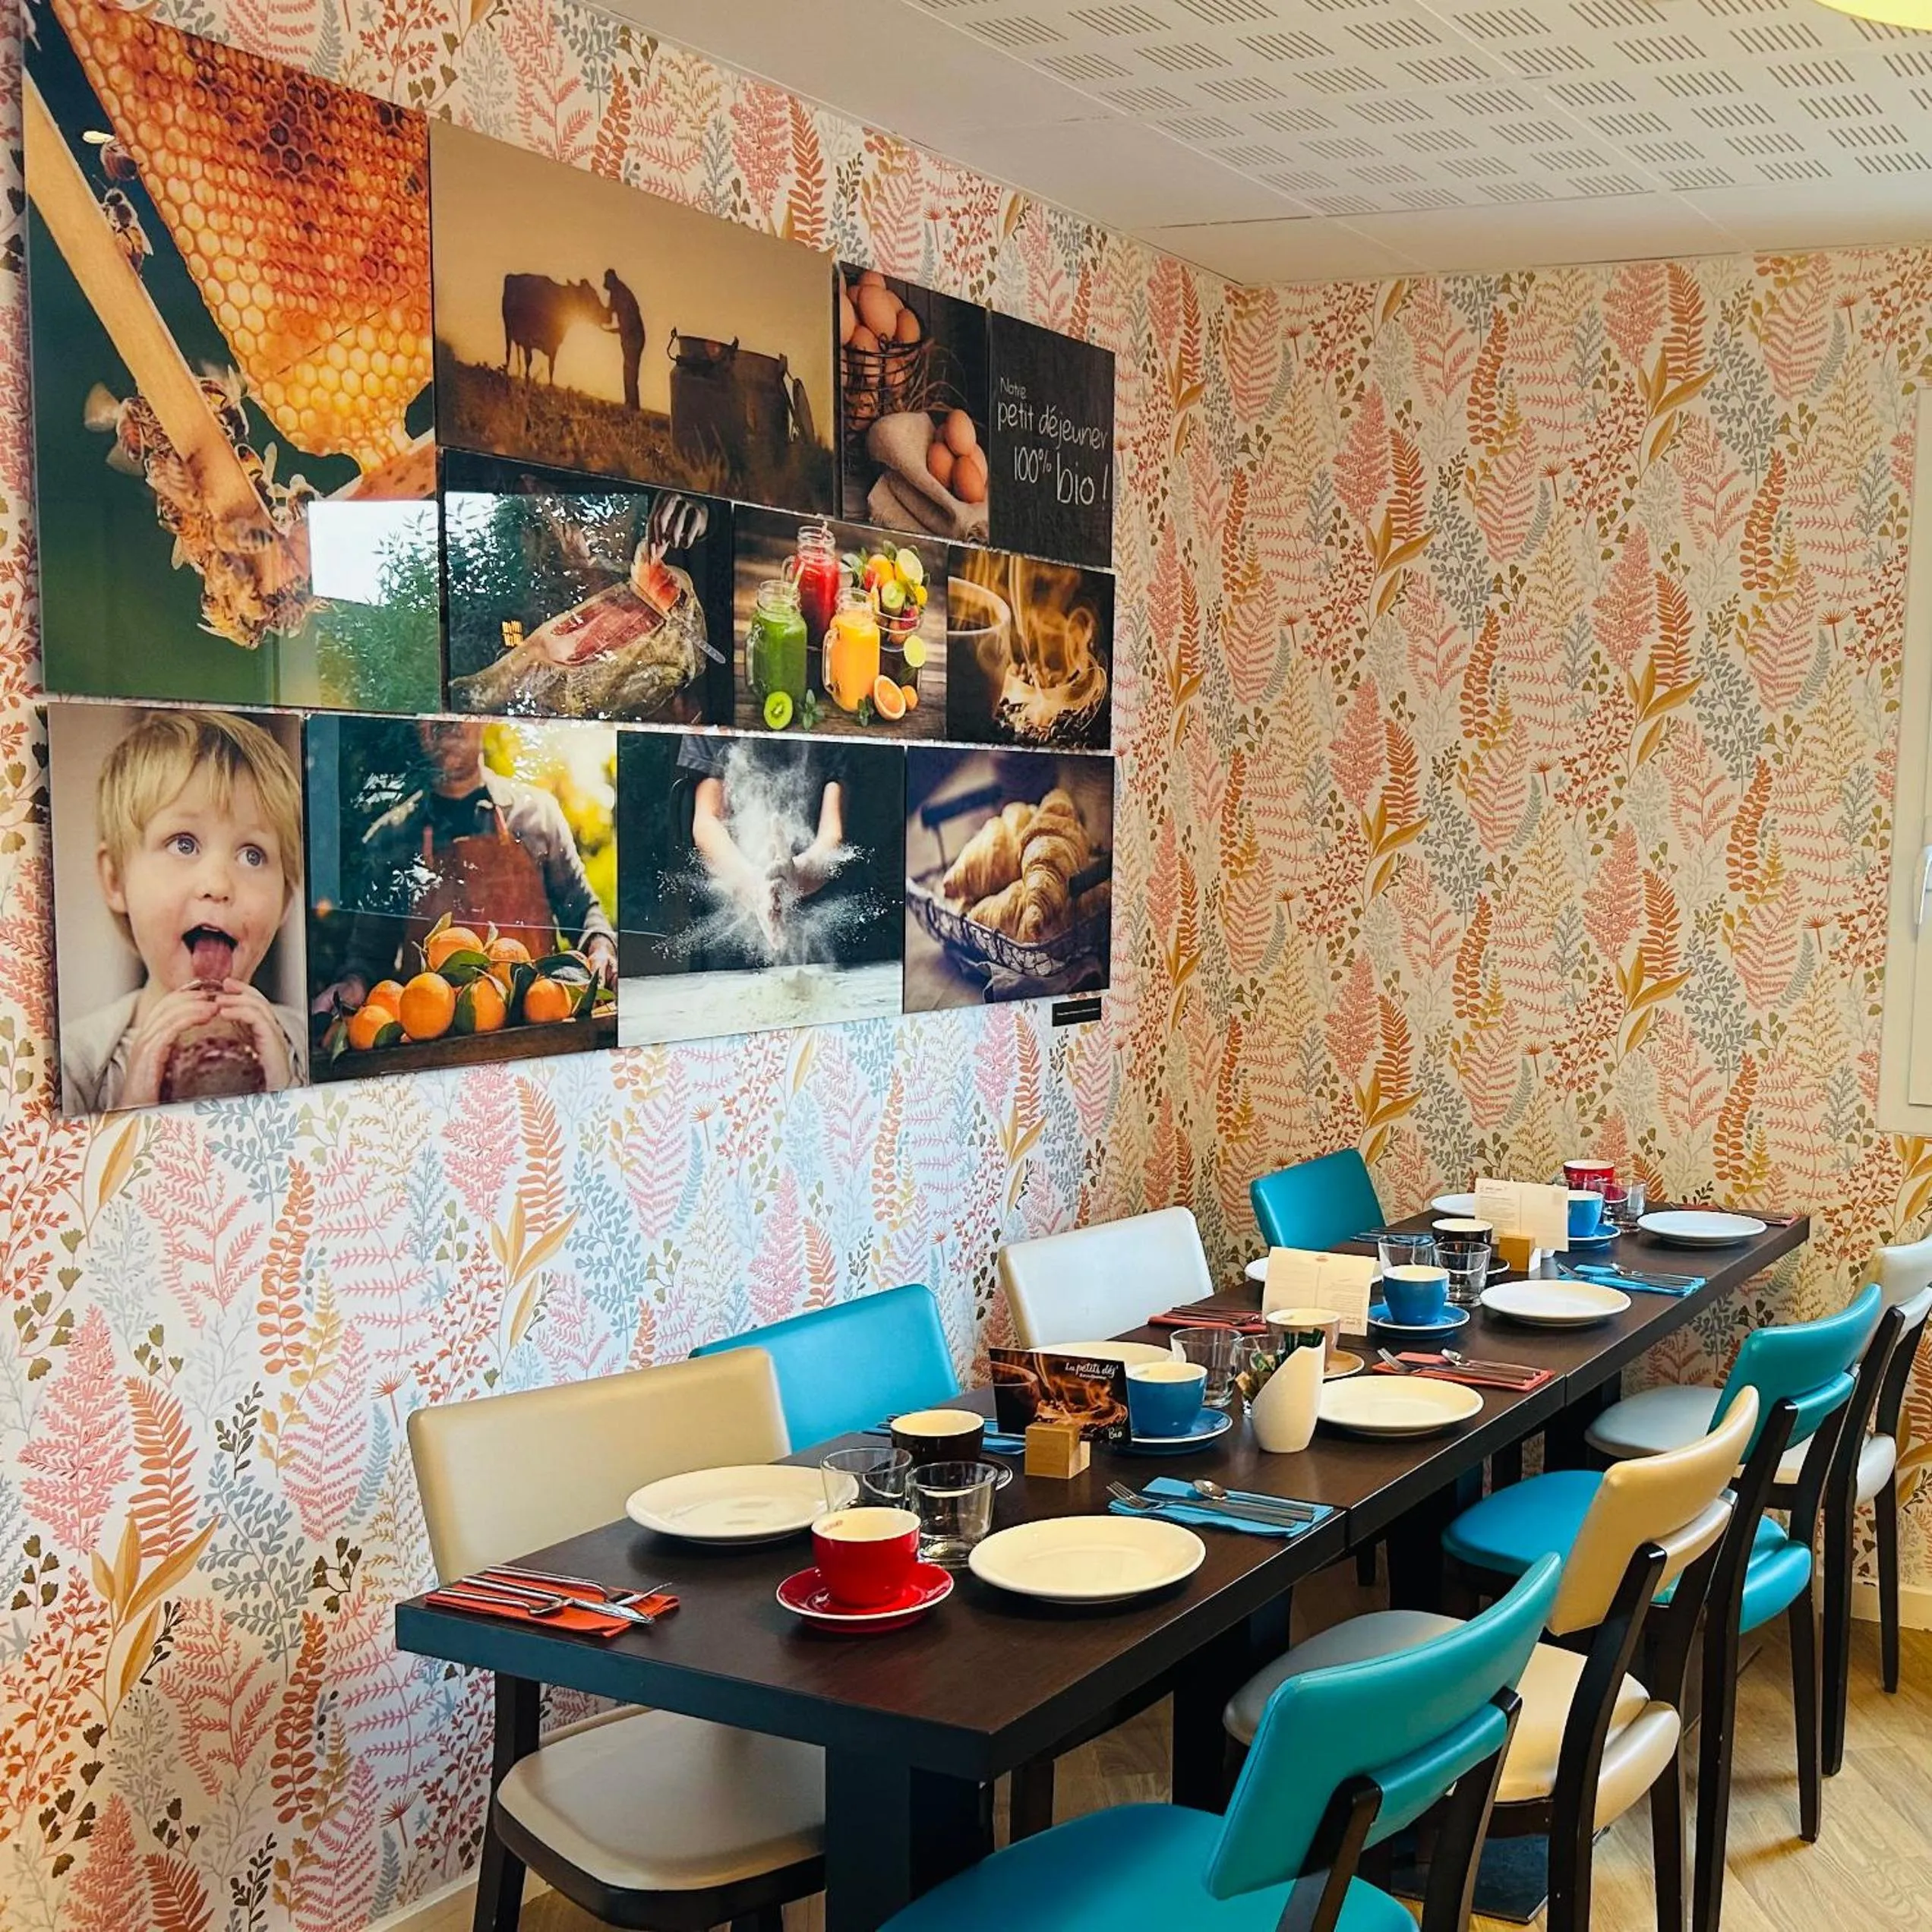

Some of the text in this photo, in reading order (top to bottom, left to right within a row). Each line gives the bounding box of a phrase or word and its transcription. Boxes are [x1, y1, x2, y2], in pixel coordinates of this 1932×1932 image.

[1000, 377, 1027, 399] Notre
[998, 401, 1108, 450] petit déjeuner
[1014, 446, 1052, 484] 100%
[1075, 1362, 1100, 1375] petits
